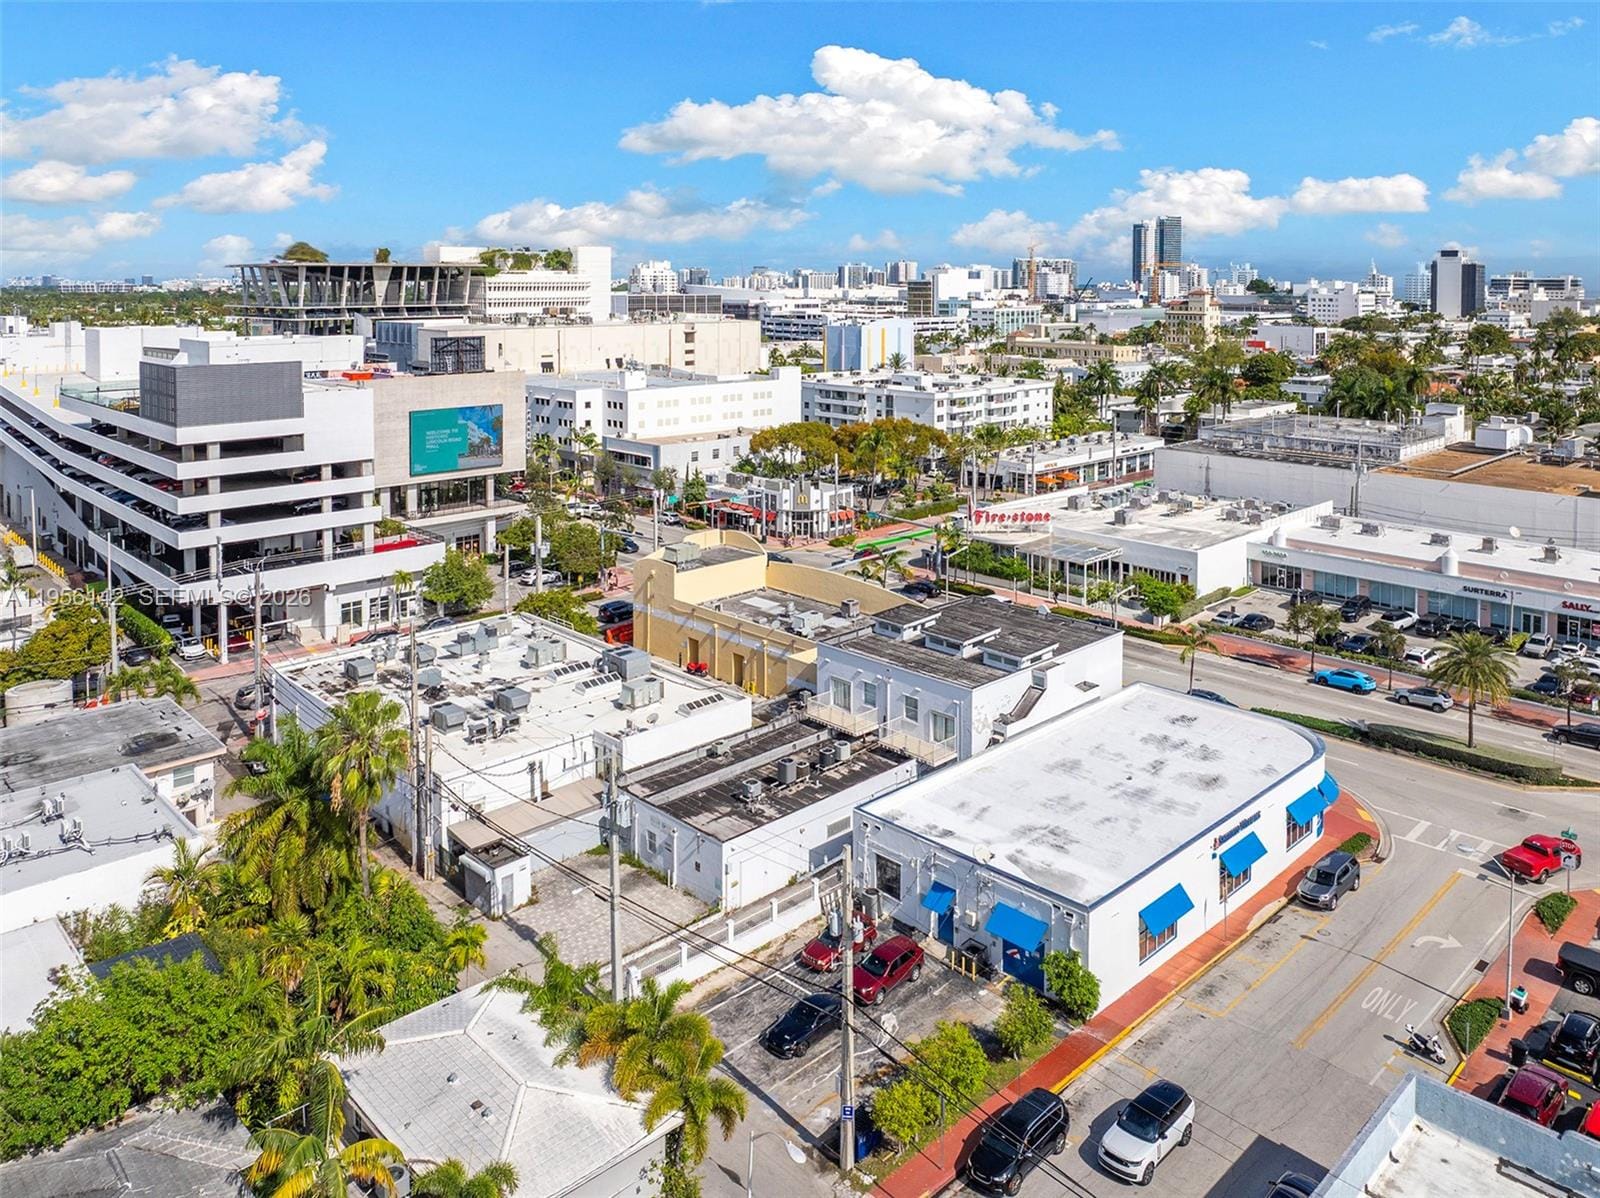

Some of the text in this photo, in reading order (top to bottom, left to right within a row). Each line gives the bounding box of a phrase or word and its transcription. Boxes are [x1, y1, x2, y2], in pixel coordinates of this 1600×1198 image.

[1463, 586, 1507, 598] SURTERRA
[1561, 600, 1591, 611] SALLY
[1561, 842, 1575, 850] STOP
[1361, 987, 1418, 1023] ONLY
